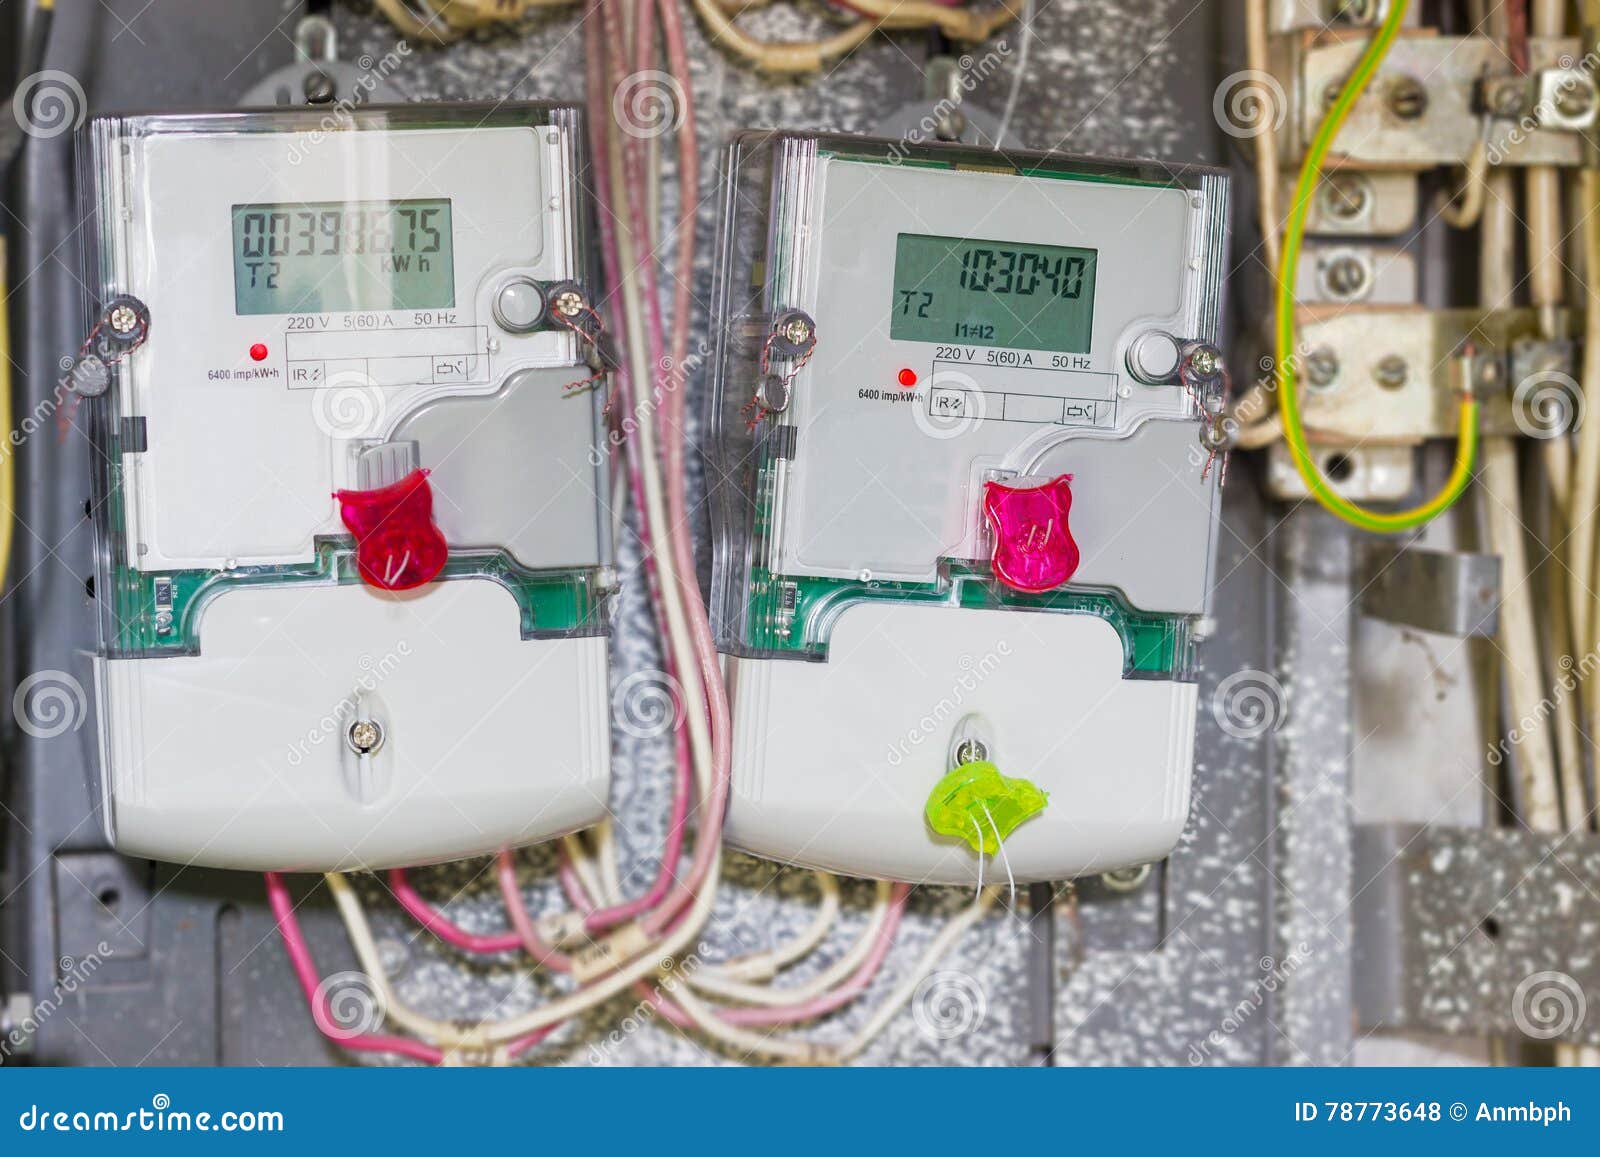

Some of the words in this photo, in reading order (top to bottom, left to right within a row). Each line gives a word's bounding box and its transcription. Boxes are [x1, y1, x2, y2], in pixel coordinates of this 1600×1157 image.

[245, 262, 280, 289] T2
[959, 249, 1085, 300] 10:30:40
[901, 290, 933, 318] T2
[287, 317, 314, 329] 220
[319, 316, 330, 328] V
[344, 315, 379, 331] 5(60)
[384, 316, 394, 326] A
[414, 313, 432, 325] 50
[437, 312, 457, 325] Hz
[936, 346, 961, 360] 220
[965, 349, 976, 361] V
[987, 351, 1020, 367] 5(60)
[1023, 353, 1033, 365] A
[1051, 355, 1069, 368] 50
[1073, 357, 1091, 369] Hz
[208, 370, 230, 380] 6400
[293, 368, 307, 380] IR
[858, 389, 880, 400] 6400
